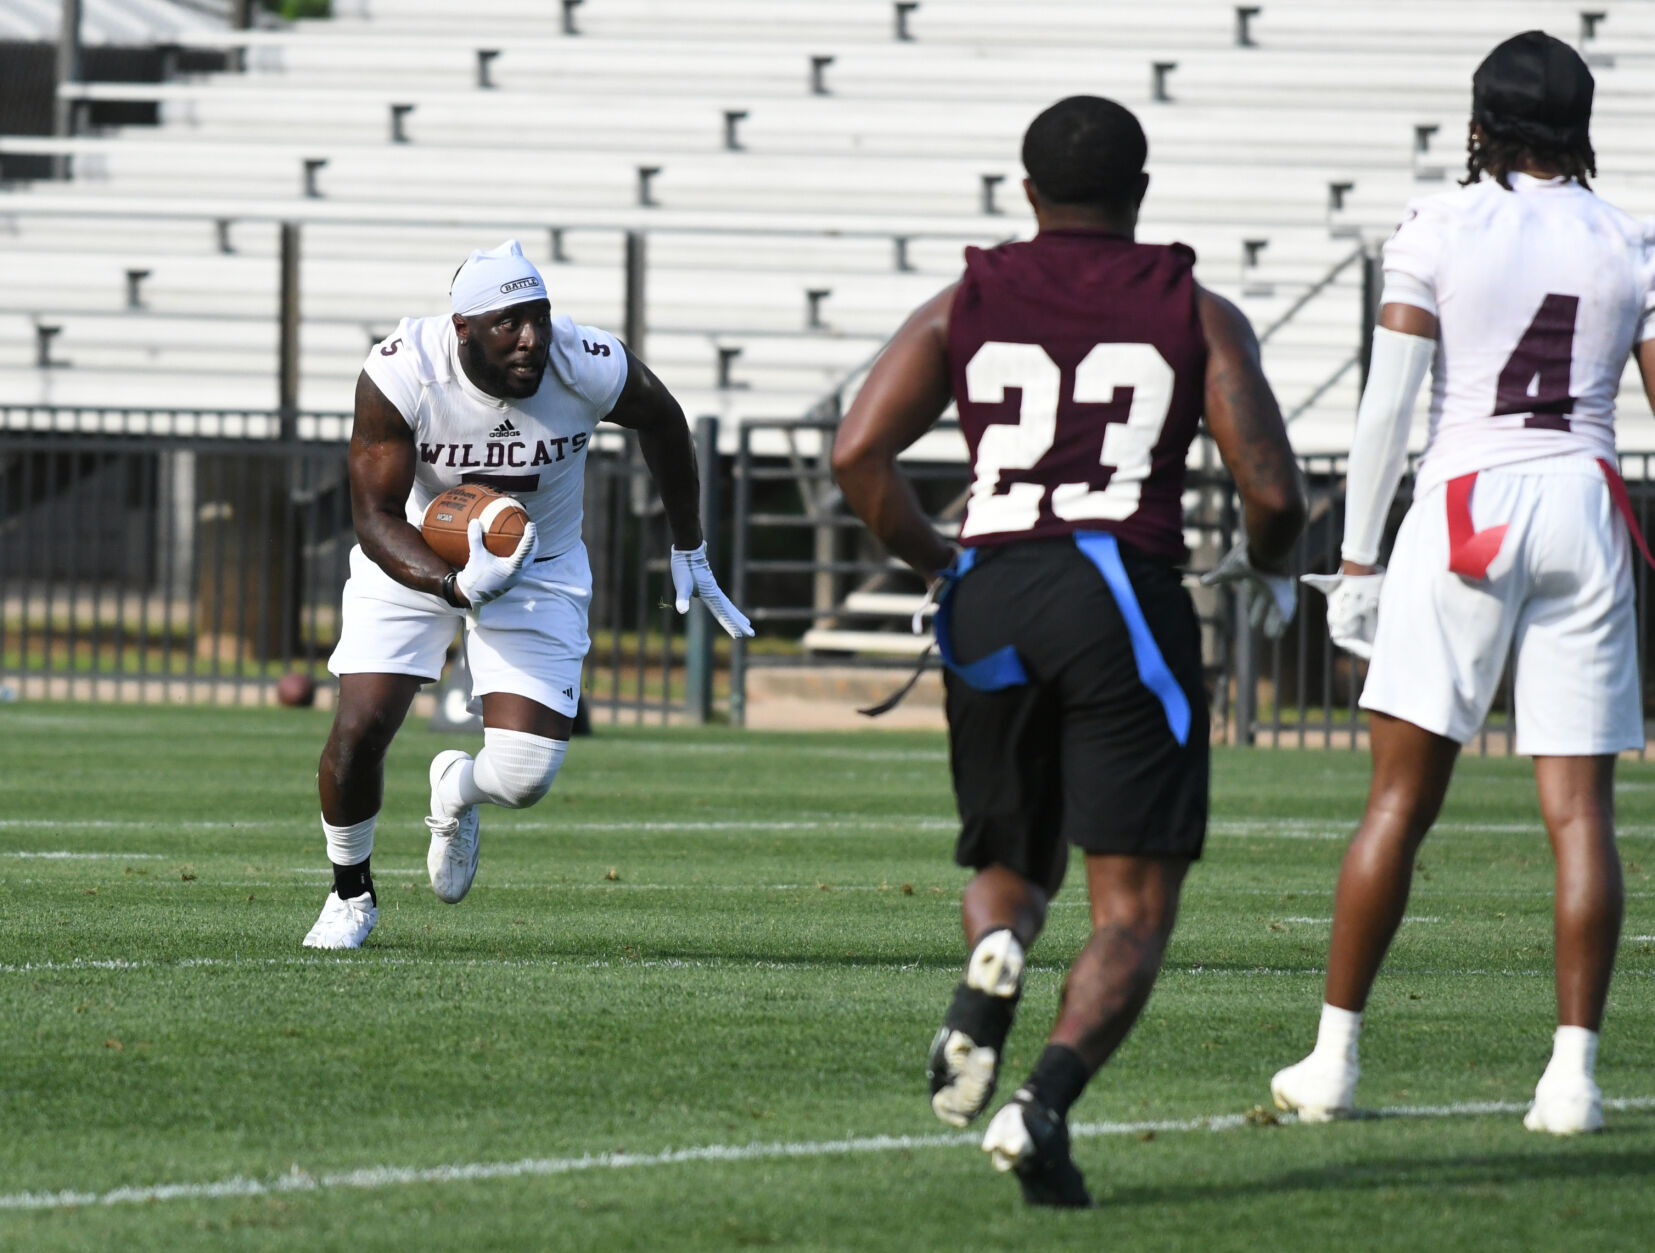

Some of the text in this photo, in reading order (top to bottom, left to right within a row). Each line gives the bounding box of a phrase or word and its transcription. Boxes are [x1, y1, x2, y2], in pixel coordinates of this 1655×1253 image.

[504, 278, 537, 292] BATTLE
[380, 338, 404, 357] 5
[582, 339, 611, 357] 5
[1490, 293, 1580, 433] 4
[489, 430, 521, 438] adidas
[960, 341, 1175, 539] 23
[420, 432, 587, 468] WILDCATS
